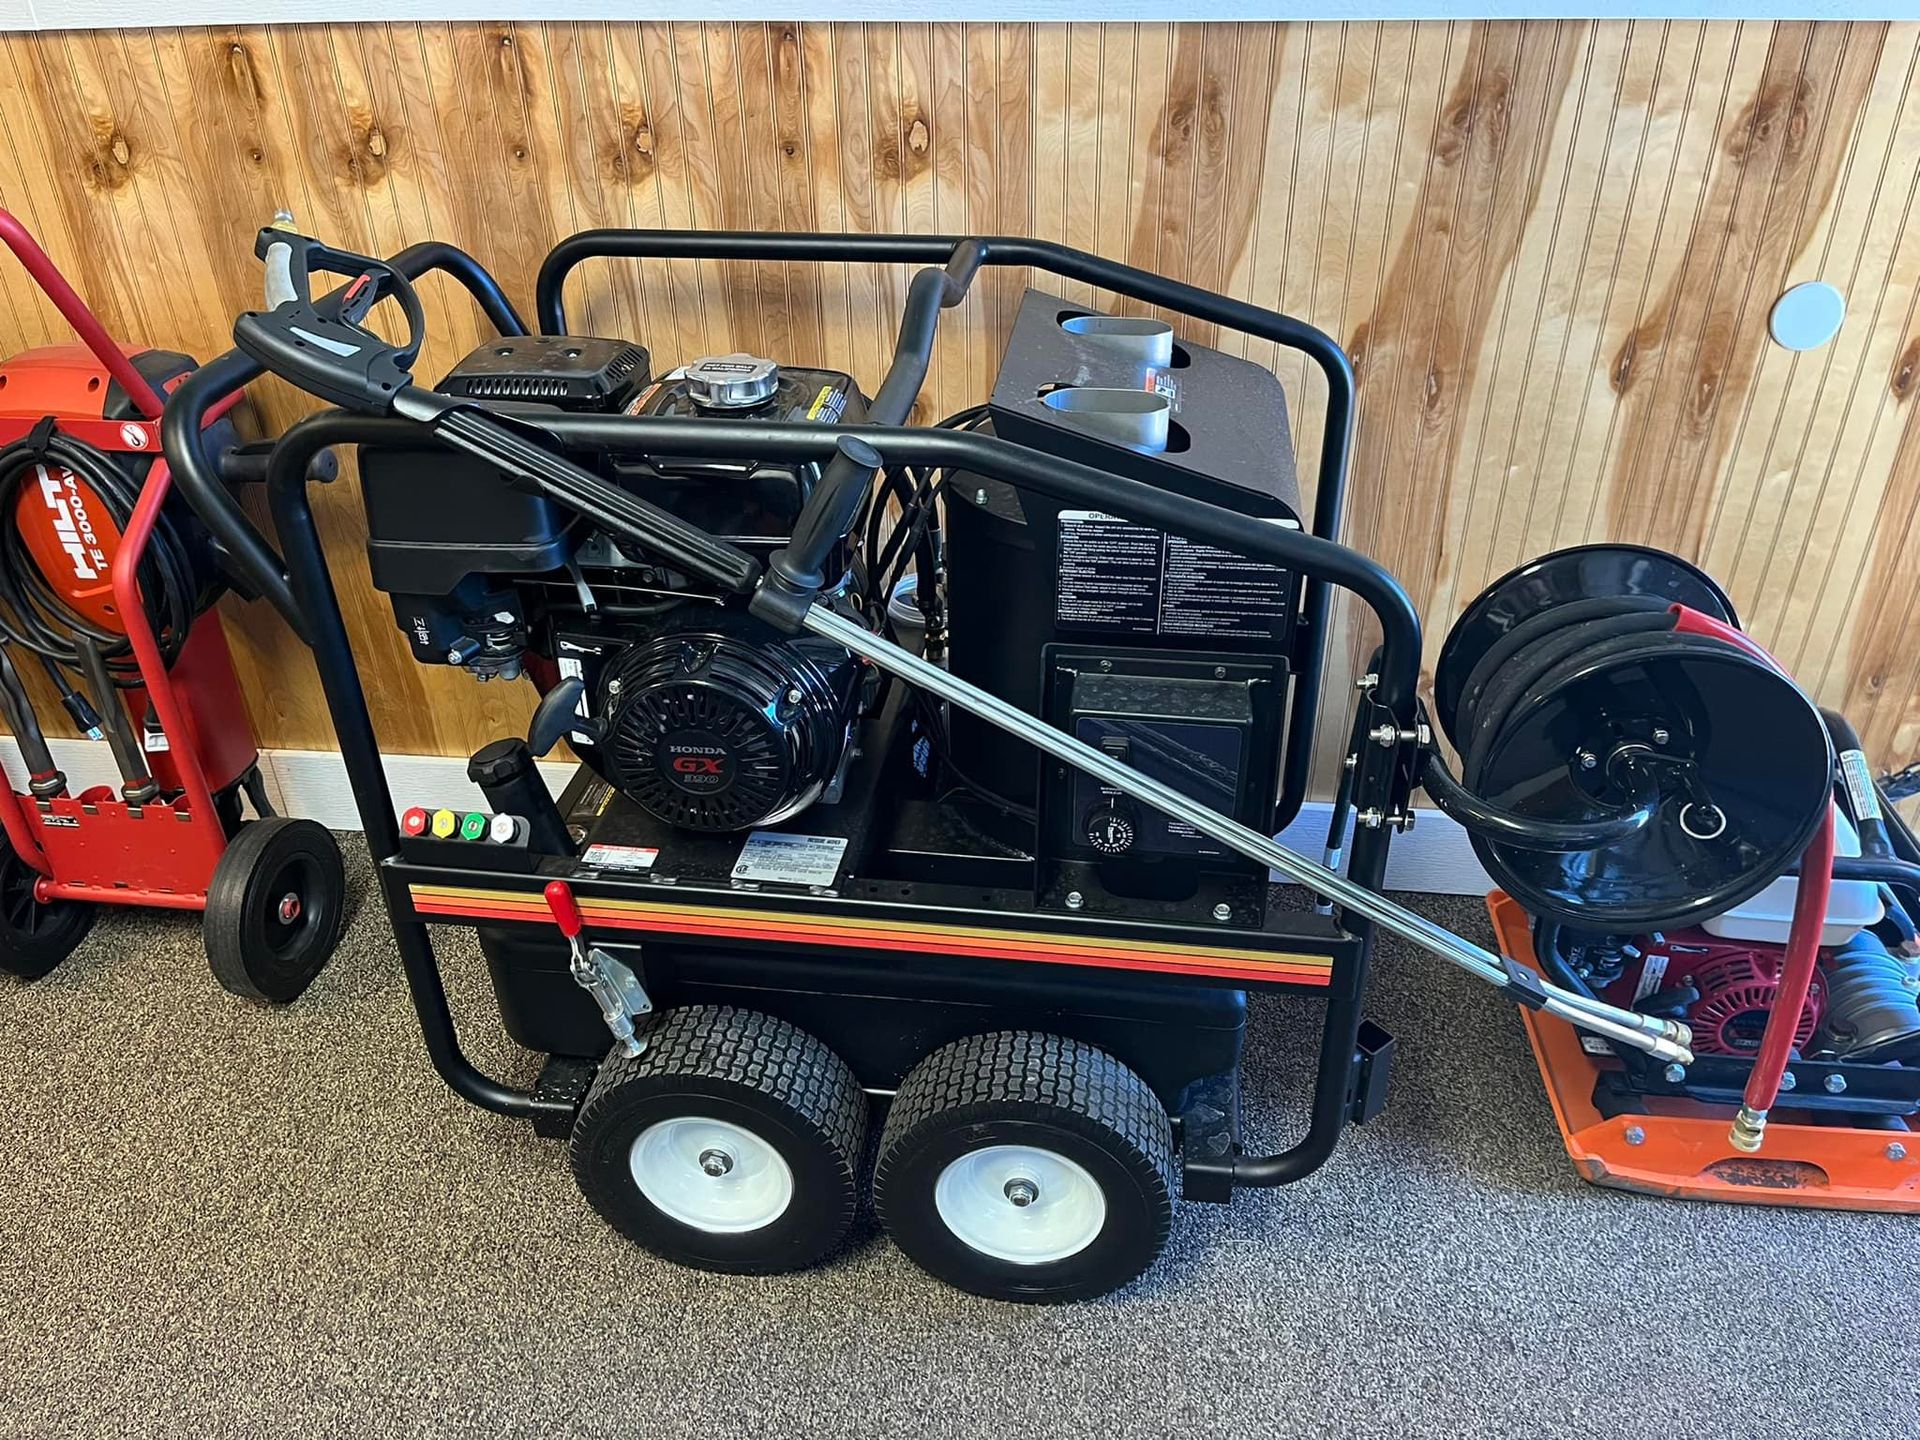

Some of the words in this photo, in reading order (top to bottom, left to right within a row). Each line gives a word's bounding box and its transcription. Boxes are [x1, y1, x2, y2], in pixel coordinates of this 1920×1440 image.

[60, 465, 97, 546] 3000-AV
[35, 463, 98, 579] HILT
[89, 549, 108, 571] TE
[669, 745, 727, 755] HONDA
[673, 757, 725, 773] GX
[683, 774, 719, 784] 390
